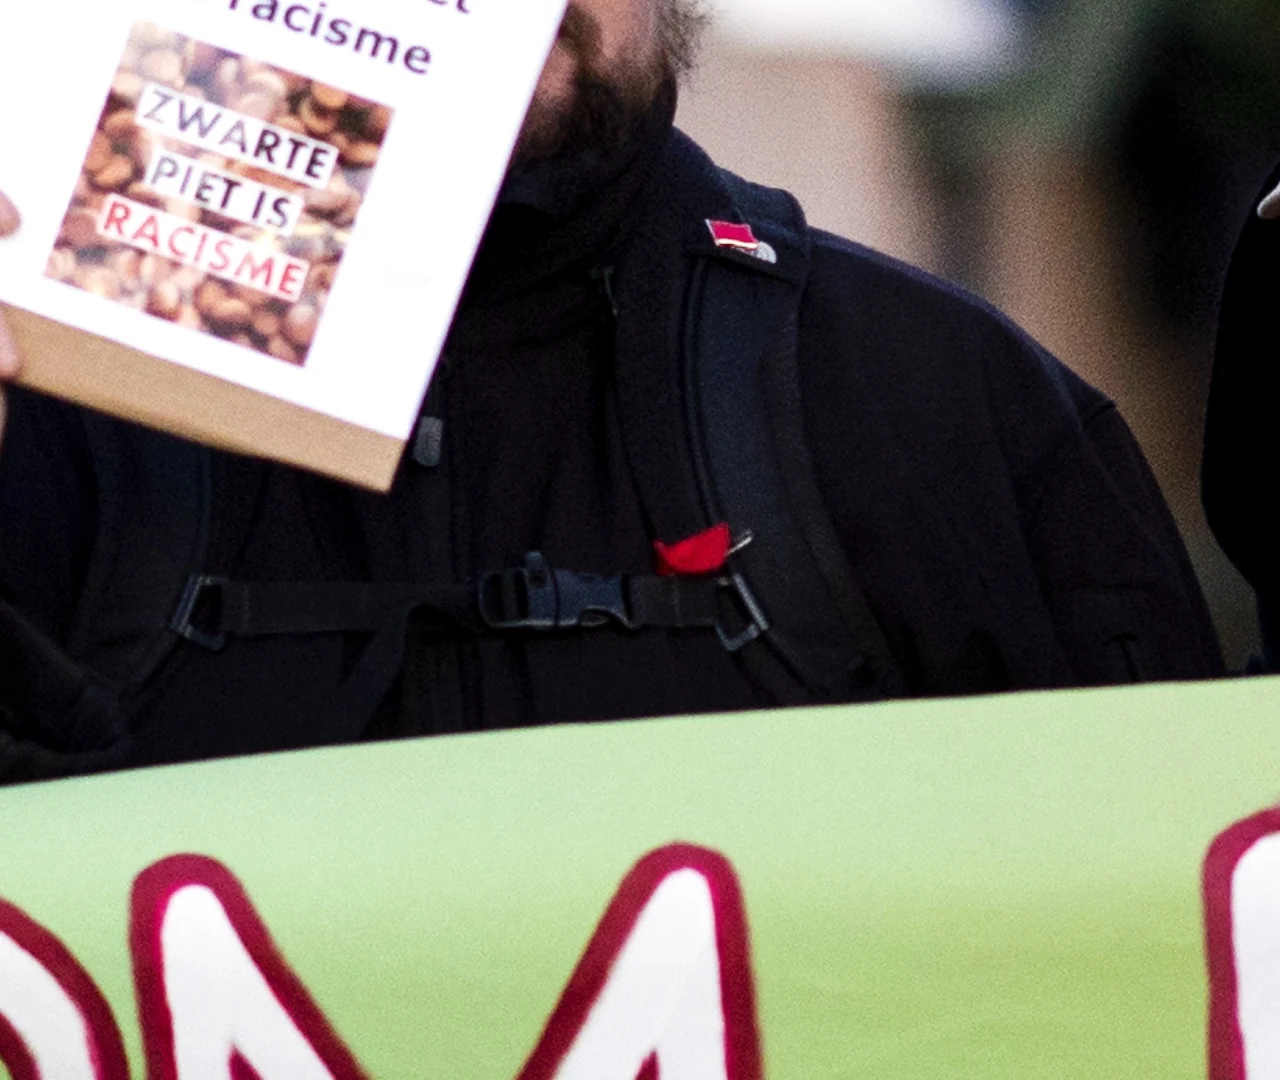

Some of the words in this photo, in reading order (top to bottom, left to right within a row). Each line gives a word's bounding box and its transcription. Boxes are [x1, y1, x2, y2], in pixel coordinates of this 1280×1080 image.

[142, 89, 330, 181] ZWARTE
[150, 155, 241, 210] PIET
[251, 190, 292, 229] IS
[103, 200, 306, 296] RACISME
